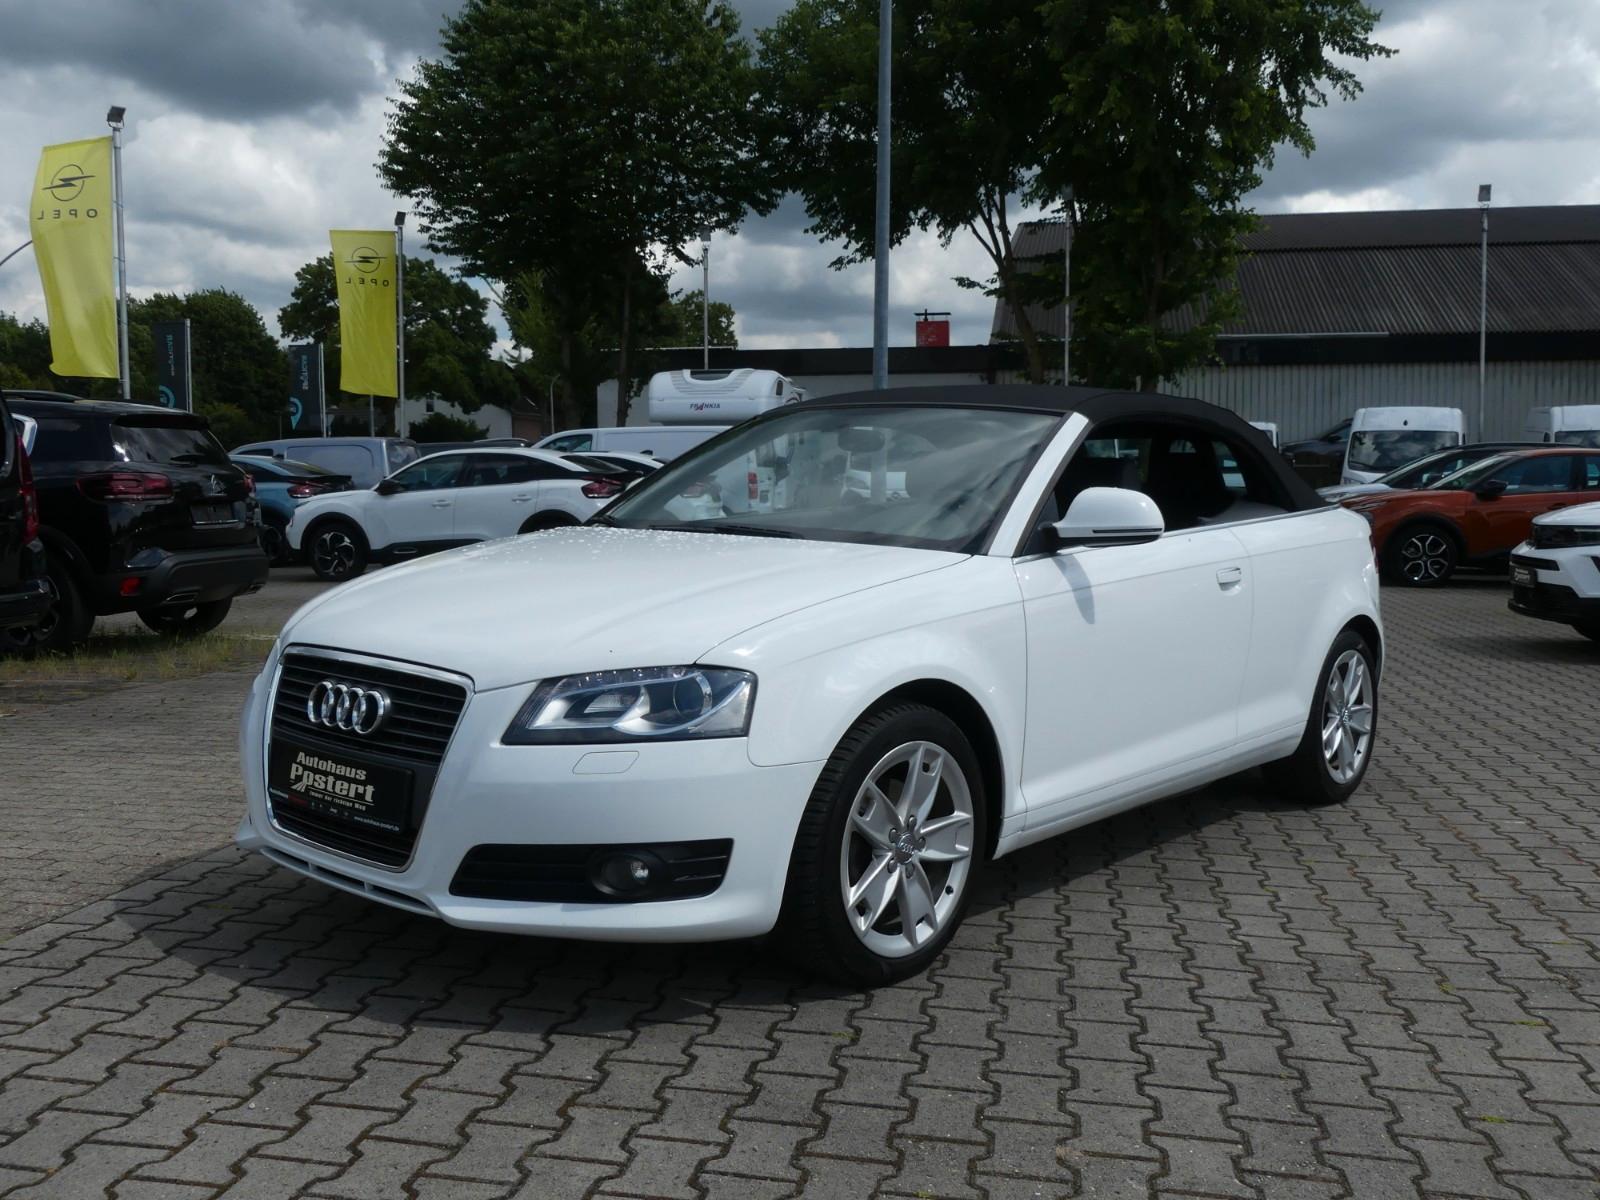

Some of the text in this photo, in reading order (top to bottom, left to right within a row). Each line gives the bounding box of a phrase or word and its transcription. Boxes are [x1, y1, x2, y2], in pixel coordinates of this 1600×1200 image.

[689, 402, 721, 411] FRANKIA
[297, 752, 367, 780] Autohaus
[289, 763, 375, 803] Postert
